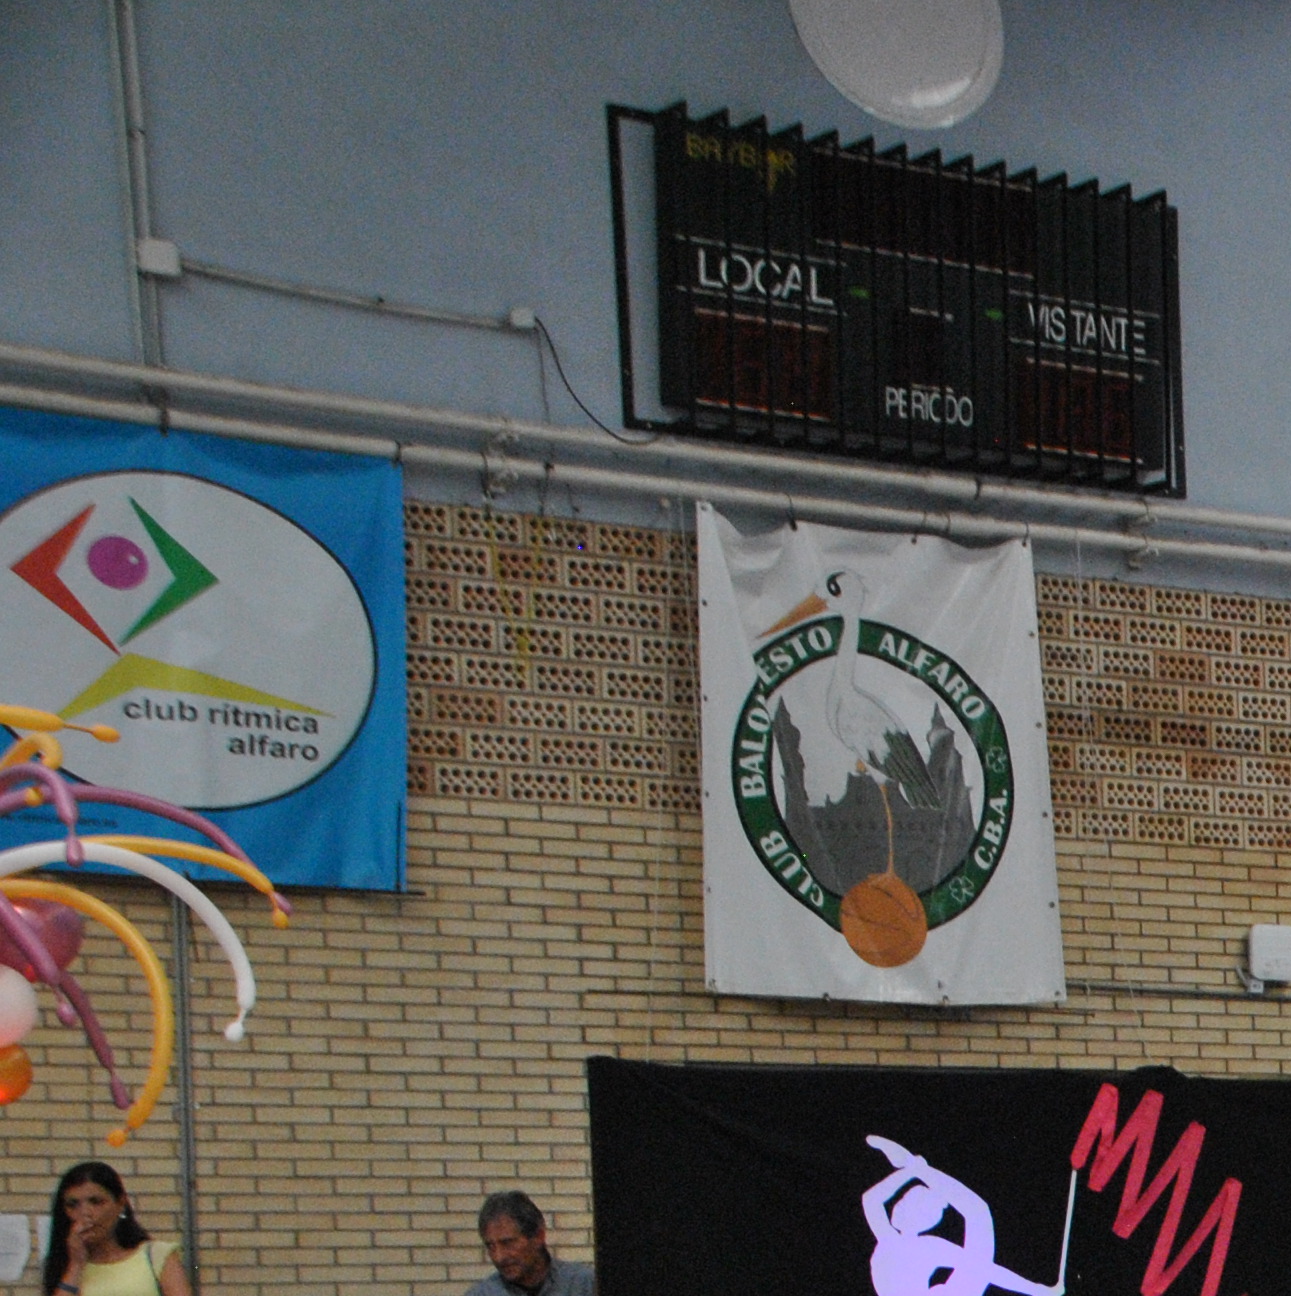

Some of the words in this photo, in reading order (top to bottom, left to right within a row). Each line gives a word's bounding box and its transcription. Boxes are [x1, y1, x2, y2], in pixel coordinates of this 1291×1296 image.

[698, 248, 834, 306] LOCAL
[1028, 302, 1146, 355] VISTANTE
[123, 697, 198, 722] club
[228, 734, 319, 761] alfaro
[760, 830, 823, 907] CLUB
[878, 631, 985, 719] ALFARO
